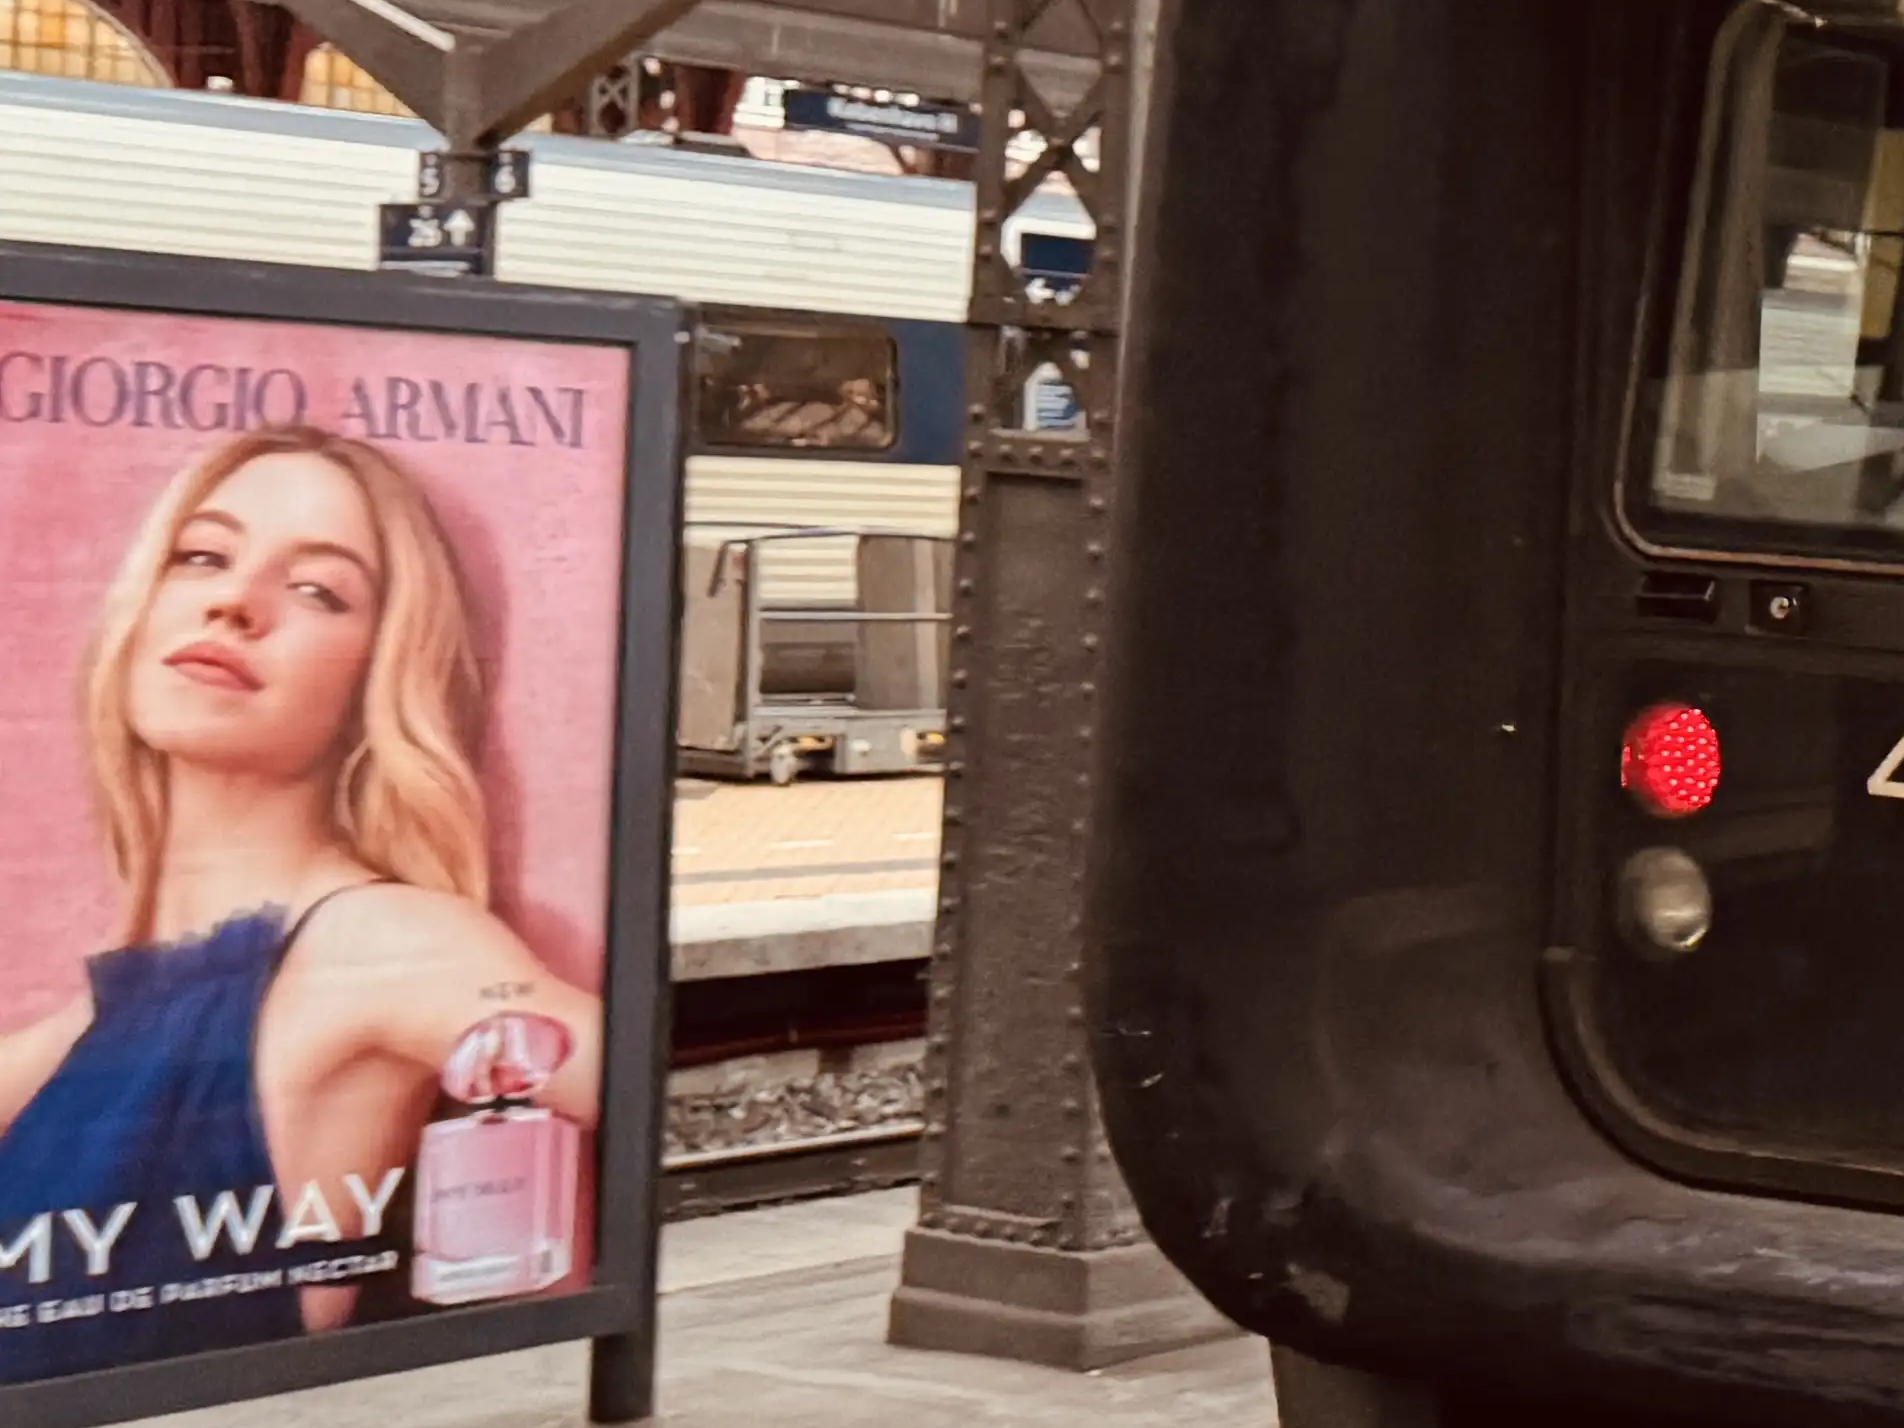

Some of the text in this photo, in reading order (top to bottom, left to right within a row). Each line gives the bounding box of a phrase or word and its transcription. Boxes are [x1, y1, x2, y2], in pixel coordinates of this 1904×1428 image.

[0, 350, 588, 449] GIORGIO ARMANI
[172, 1166, 406, 1262] WAY
[36, 1293, 105, 1324] EAU
[109, 1285, 155, 1311] DE
[159, 1269, 283, 1304] PARFUM
[287, 1249, 400, 1285] NECTAR
